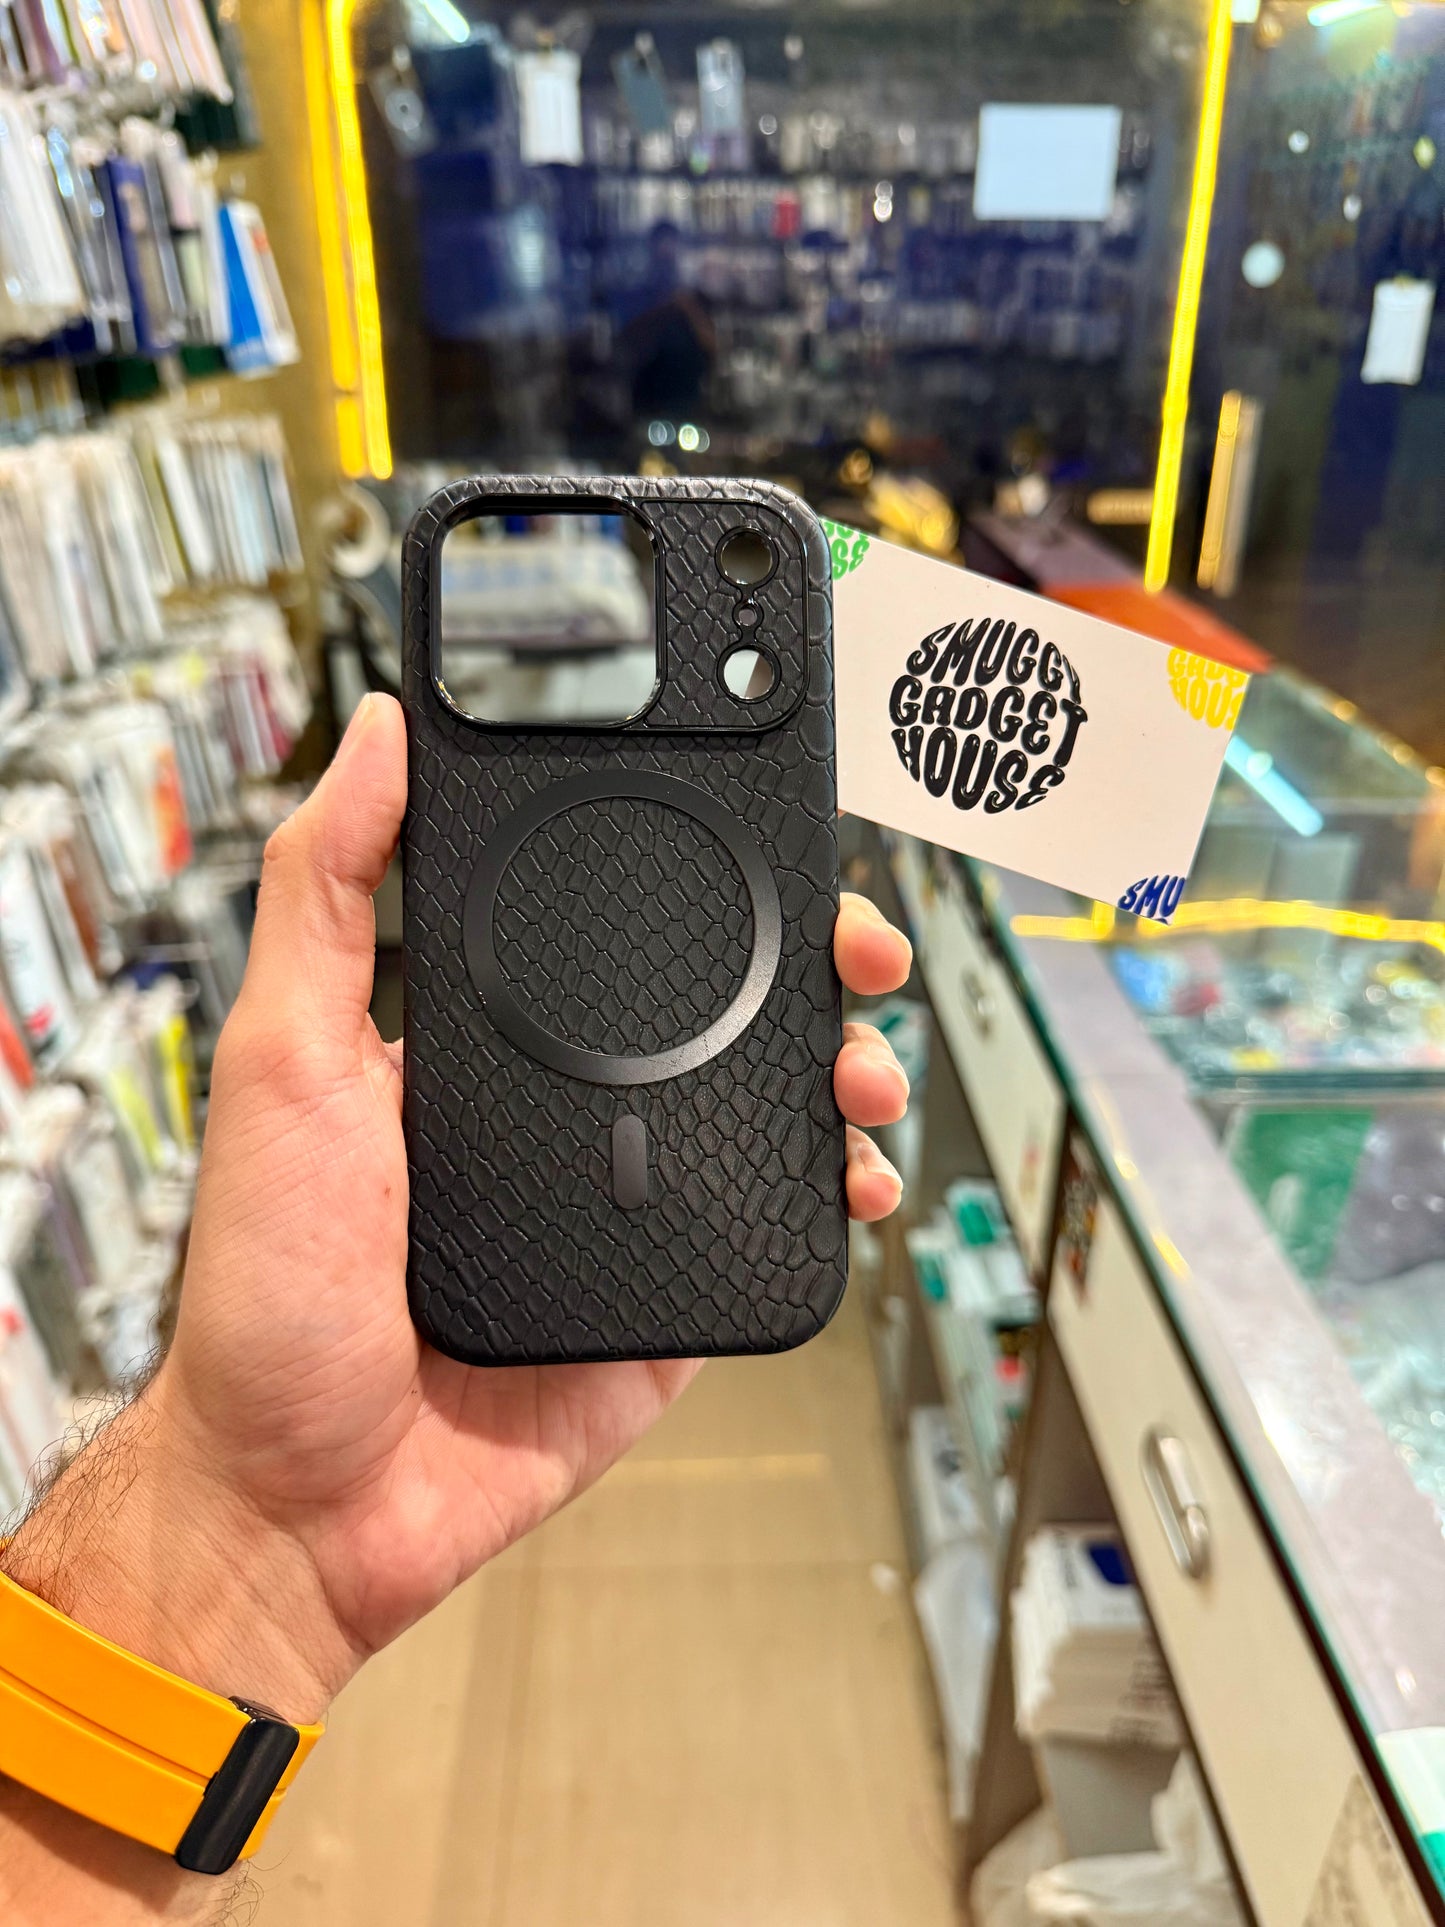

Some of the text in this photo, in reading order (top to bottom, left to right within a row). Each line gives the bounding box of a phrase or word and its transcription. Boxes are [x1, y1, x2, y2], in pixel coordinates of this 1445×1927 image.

[906, 617, 1082, 704] SMUGGY
[889, 675, 1088, 768] GADGET
[891, 725, 1065, 814] HOUSE
